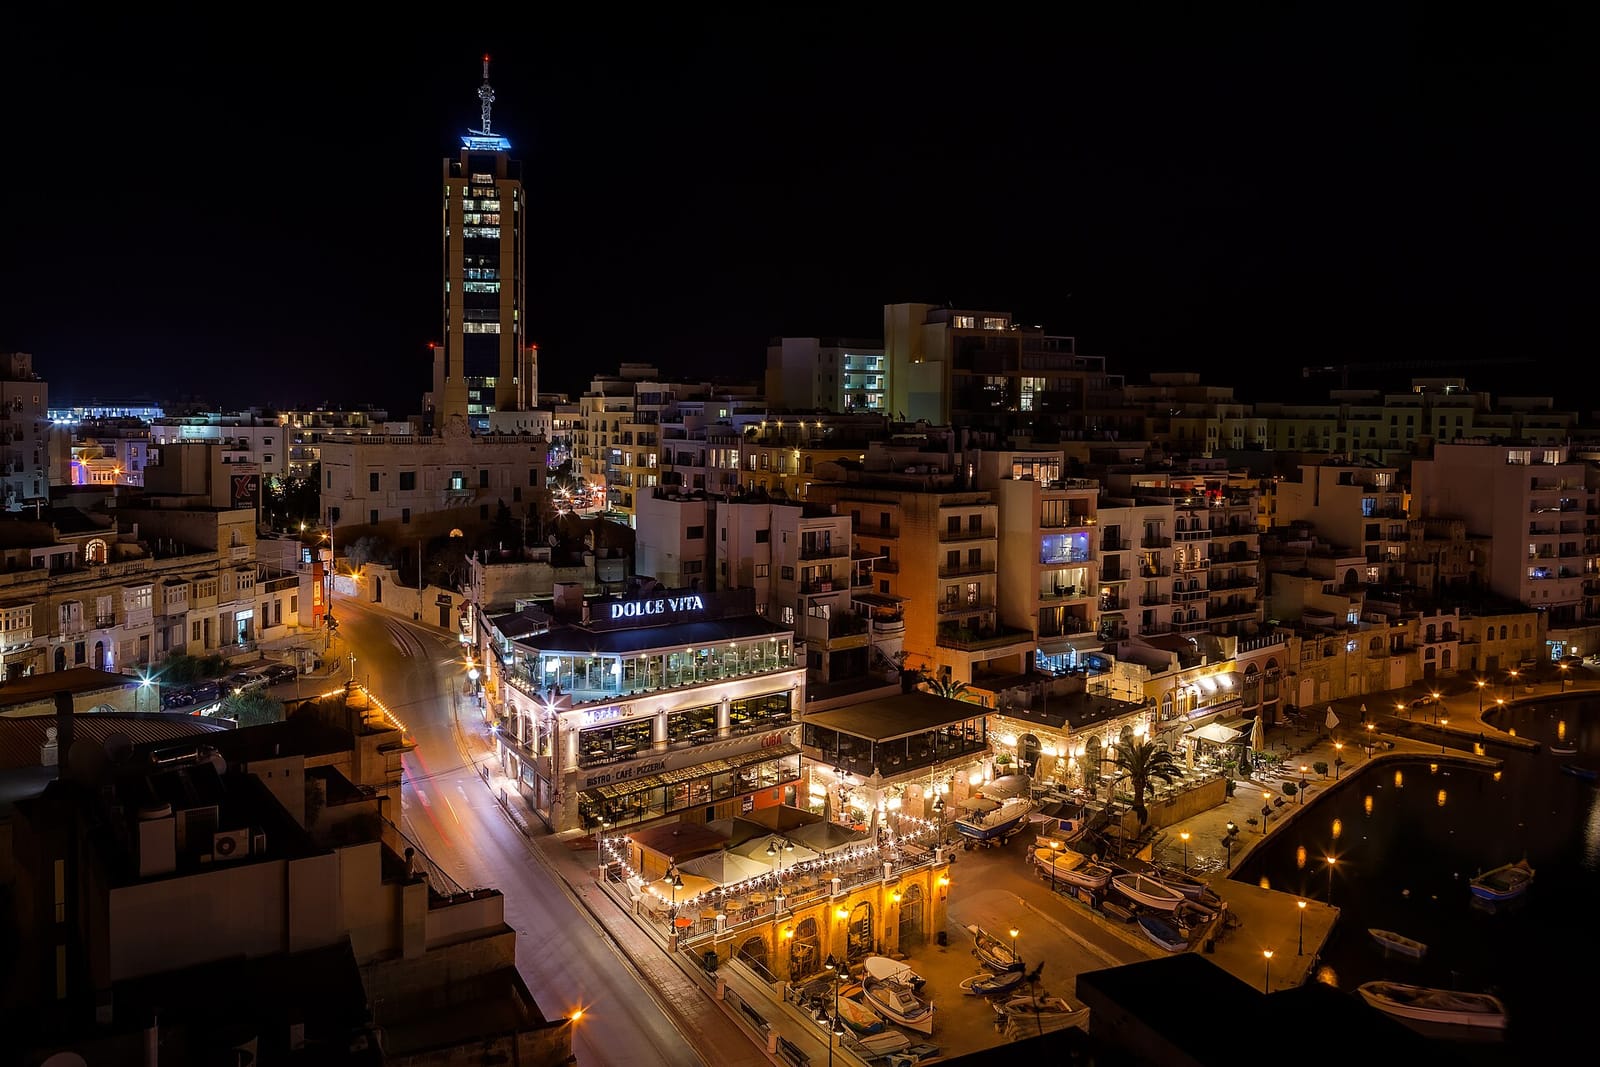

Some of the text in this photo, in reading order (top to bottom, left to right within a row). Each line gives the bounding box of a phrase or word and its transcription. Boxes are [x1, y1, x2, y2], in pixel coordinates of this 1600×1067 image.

[611, 595, 703, 619] DOLCE VITA
[761, 734, 782, 748] CUBA
[586, 760, 666, 787] BISTRO CAFÉ PIZZERIA
[742, 909, 759, 921] CUBA
